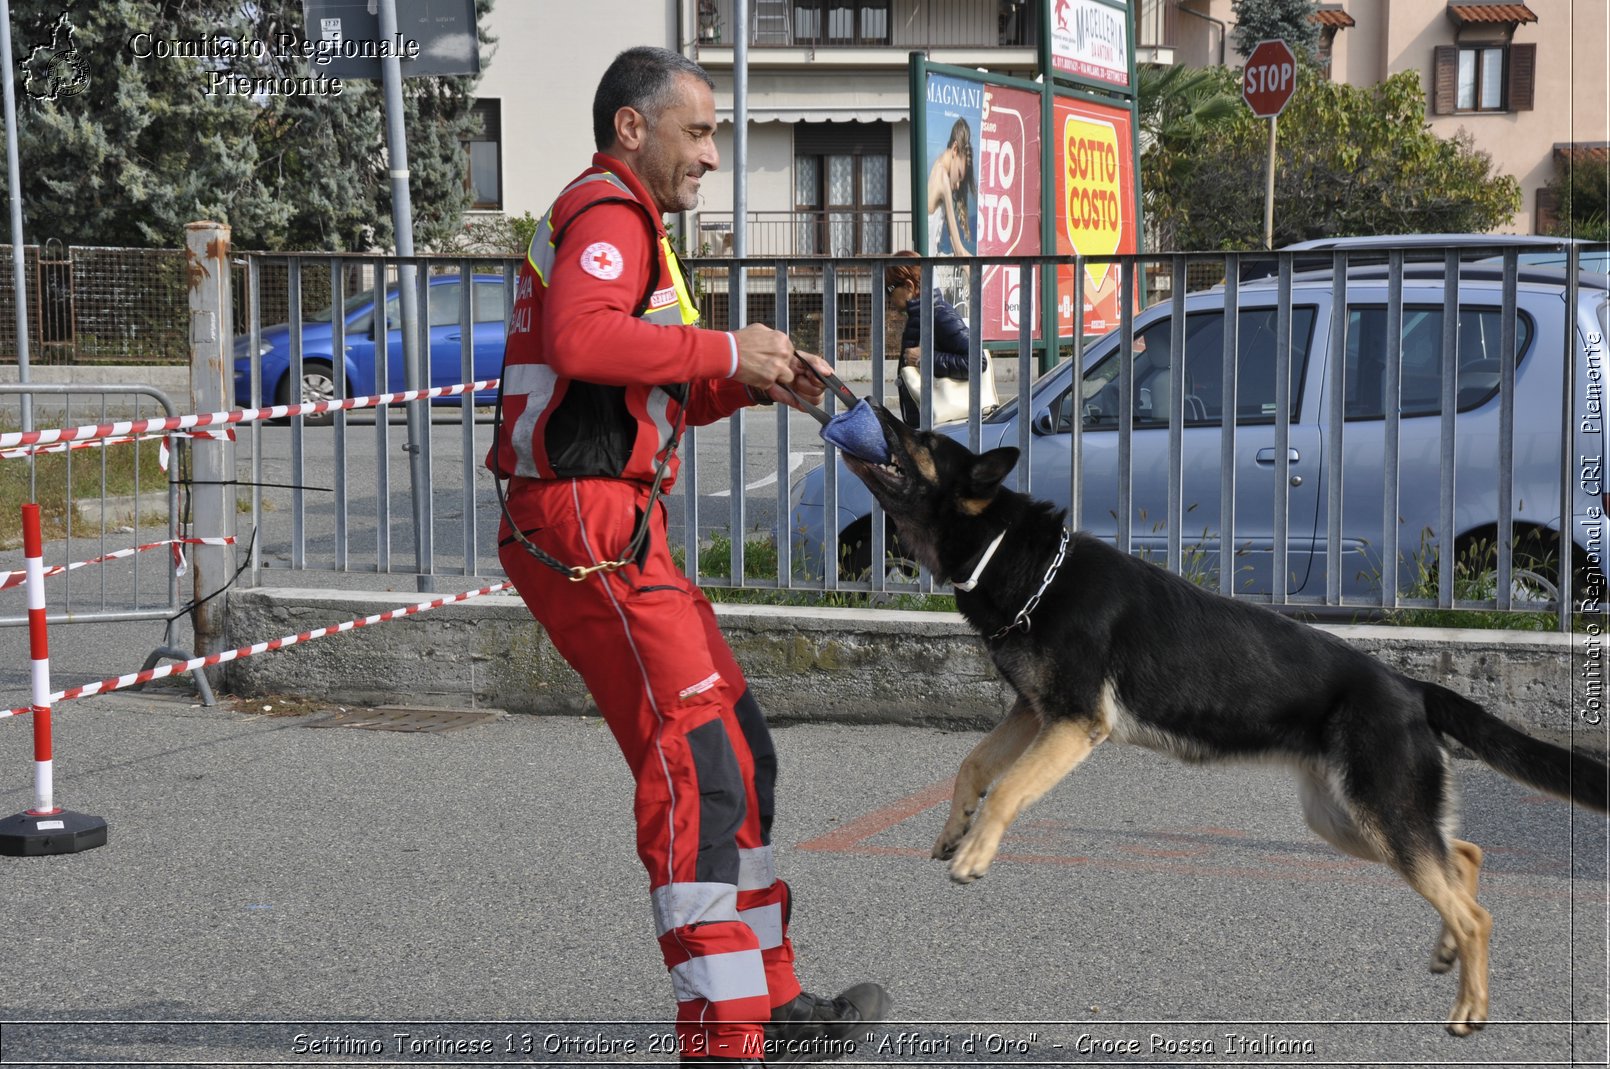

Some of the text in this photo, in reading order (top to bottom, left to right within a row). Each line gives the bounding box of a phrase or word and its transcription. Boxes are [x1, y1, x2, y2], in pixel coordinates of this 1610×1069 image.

[1075, 6, 1125, 67] MACELLERIA
[927, 82, 981, 109] MAGNANI
[1246, 63, 1292, 94] STOP
[1068, 135, 1116, 184] SOTTO
[1069, 186, 1118, 233] COSTO
